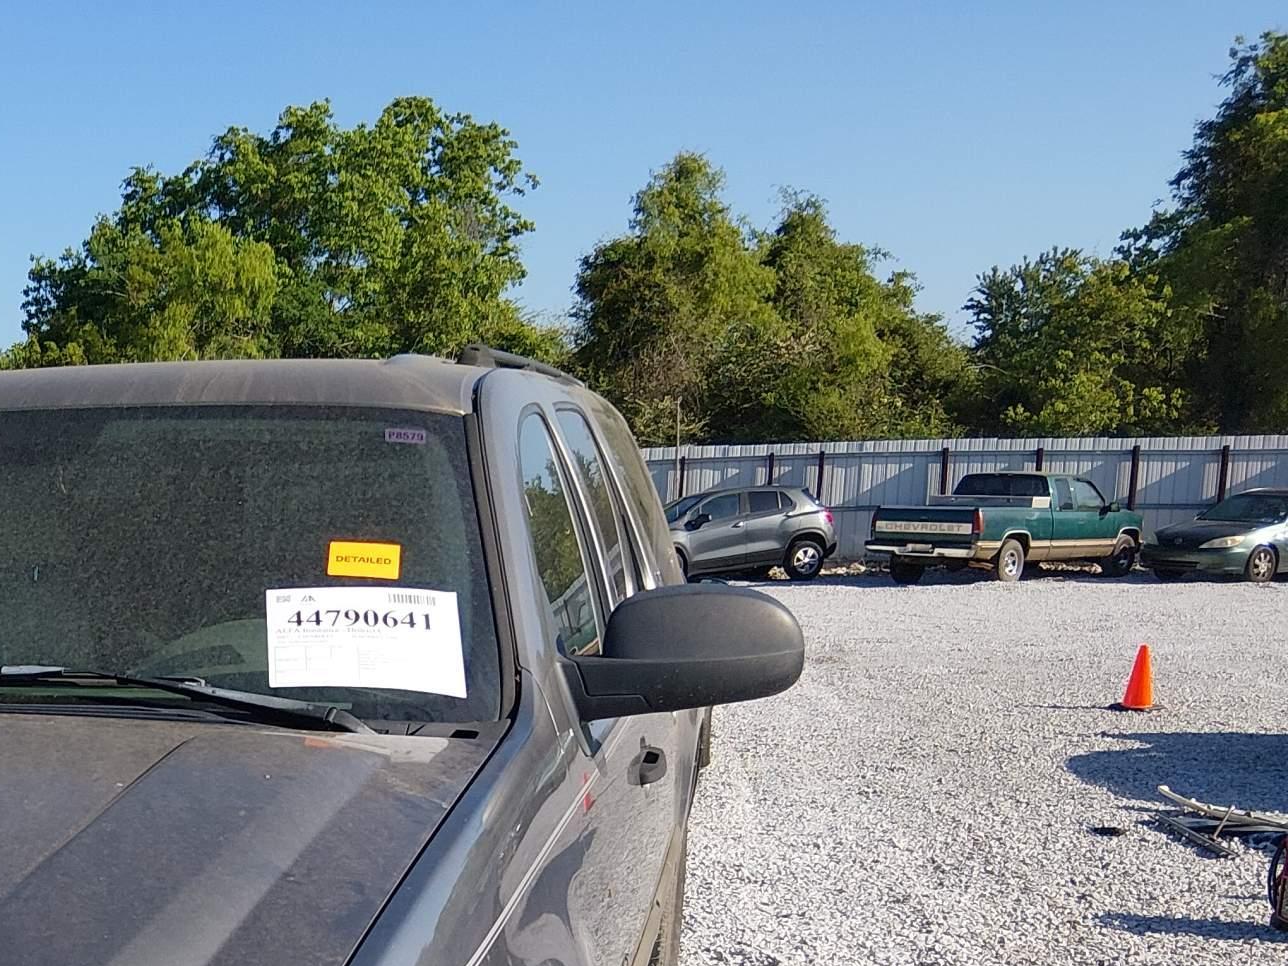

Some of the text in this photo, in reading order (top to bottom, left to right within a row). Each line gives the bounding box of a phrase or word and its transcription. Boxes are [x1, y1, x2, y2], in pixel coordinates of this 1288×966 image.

[885, 522, 963, 532] CHEVROLET
[335, 554, 392, 565] DETAILED
[287, 608, 431, 631] 44790641
